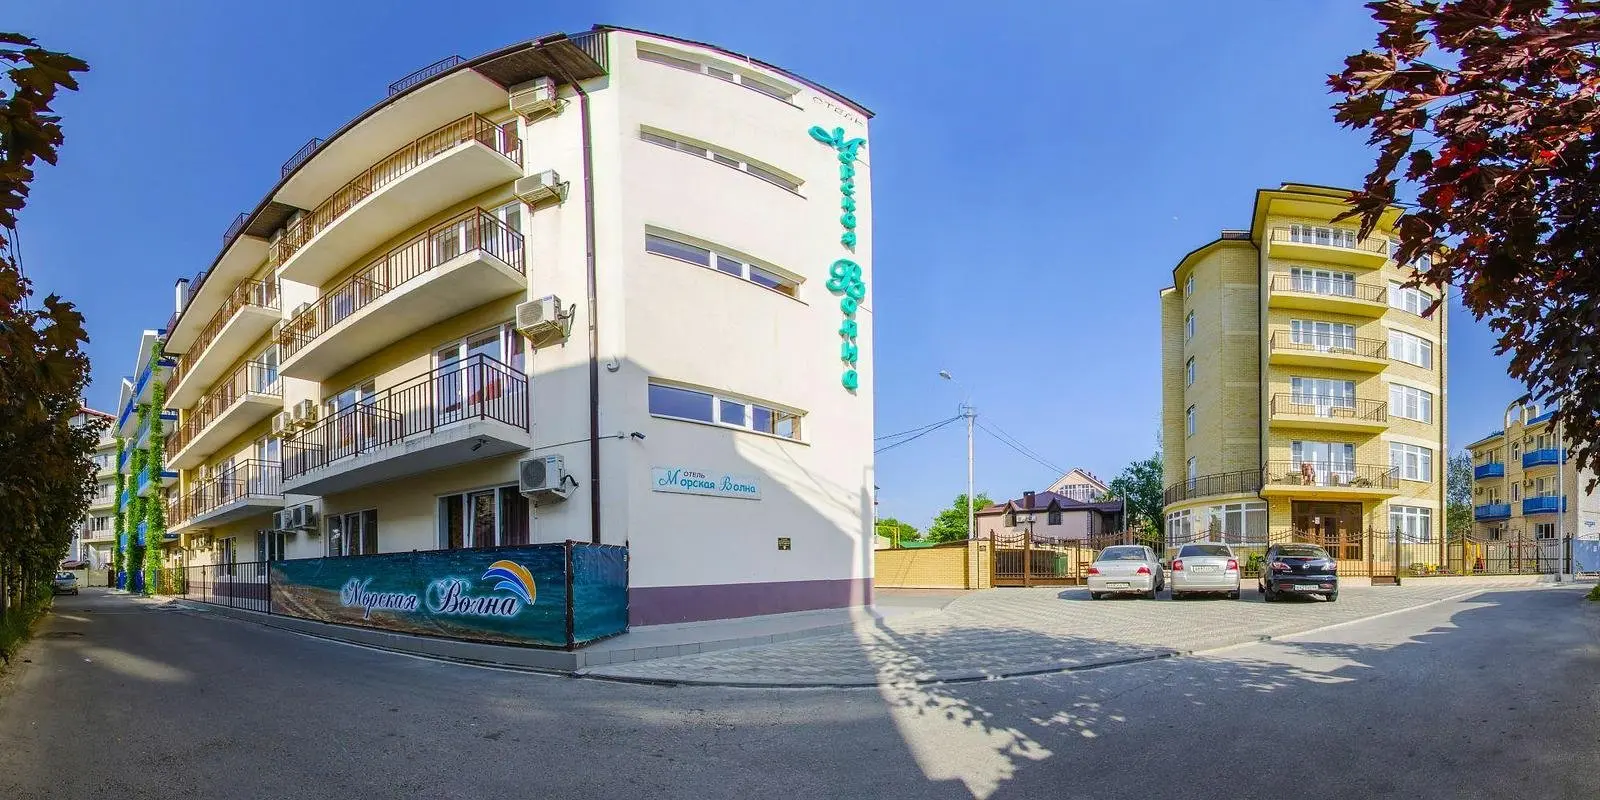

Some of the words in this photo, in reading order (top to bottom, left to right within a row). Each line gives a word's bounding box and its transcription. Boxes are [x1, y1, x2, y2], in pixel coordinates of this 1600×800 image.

[807, 125, 867, 249] Морская
[825, 258, 866, 391] Волна
[658, 469, 716, 490] Морская
[719, 476, 756, 493] Волна
[341, 577, 419, 619] Морская
[426, 577, 520, 617] Волна
